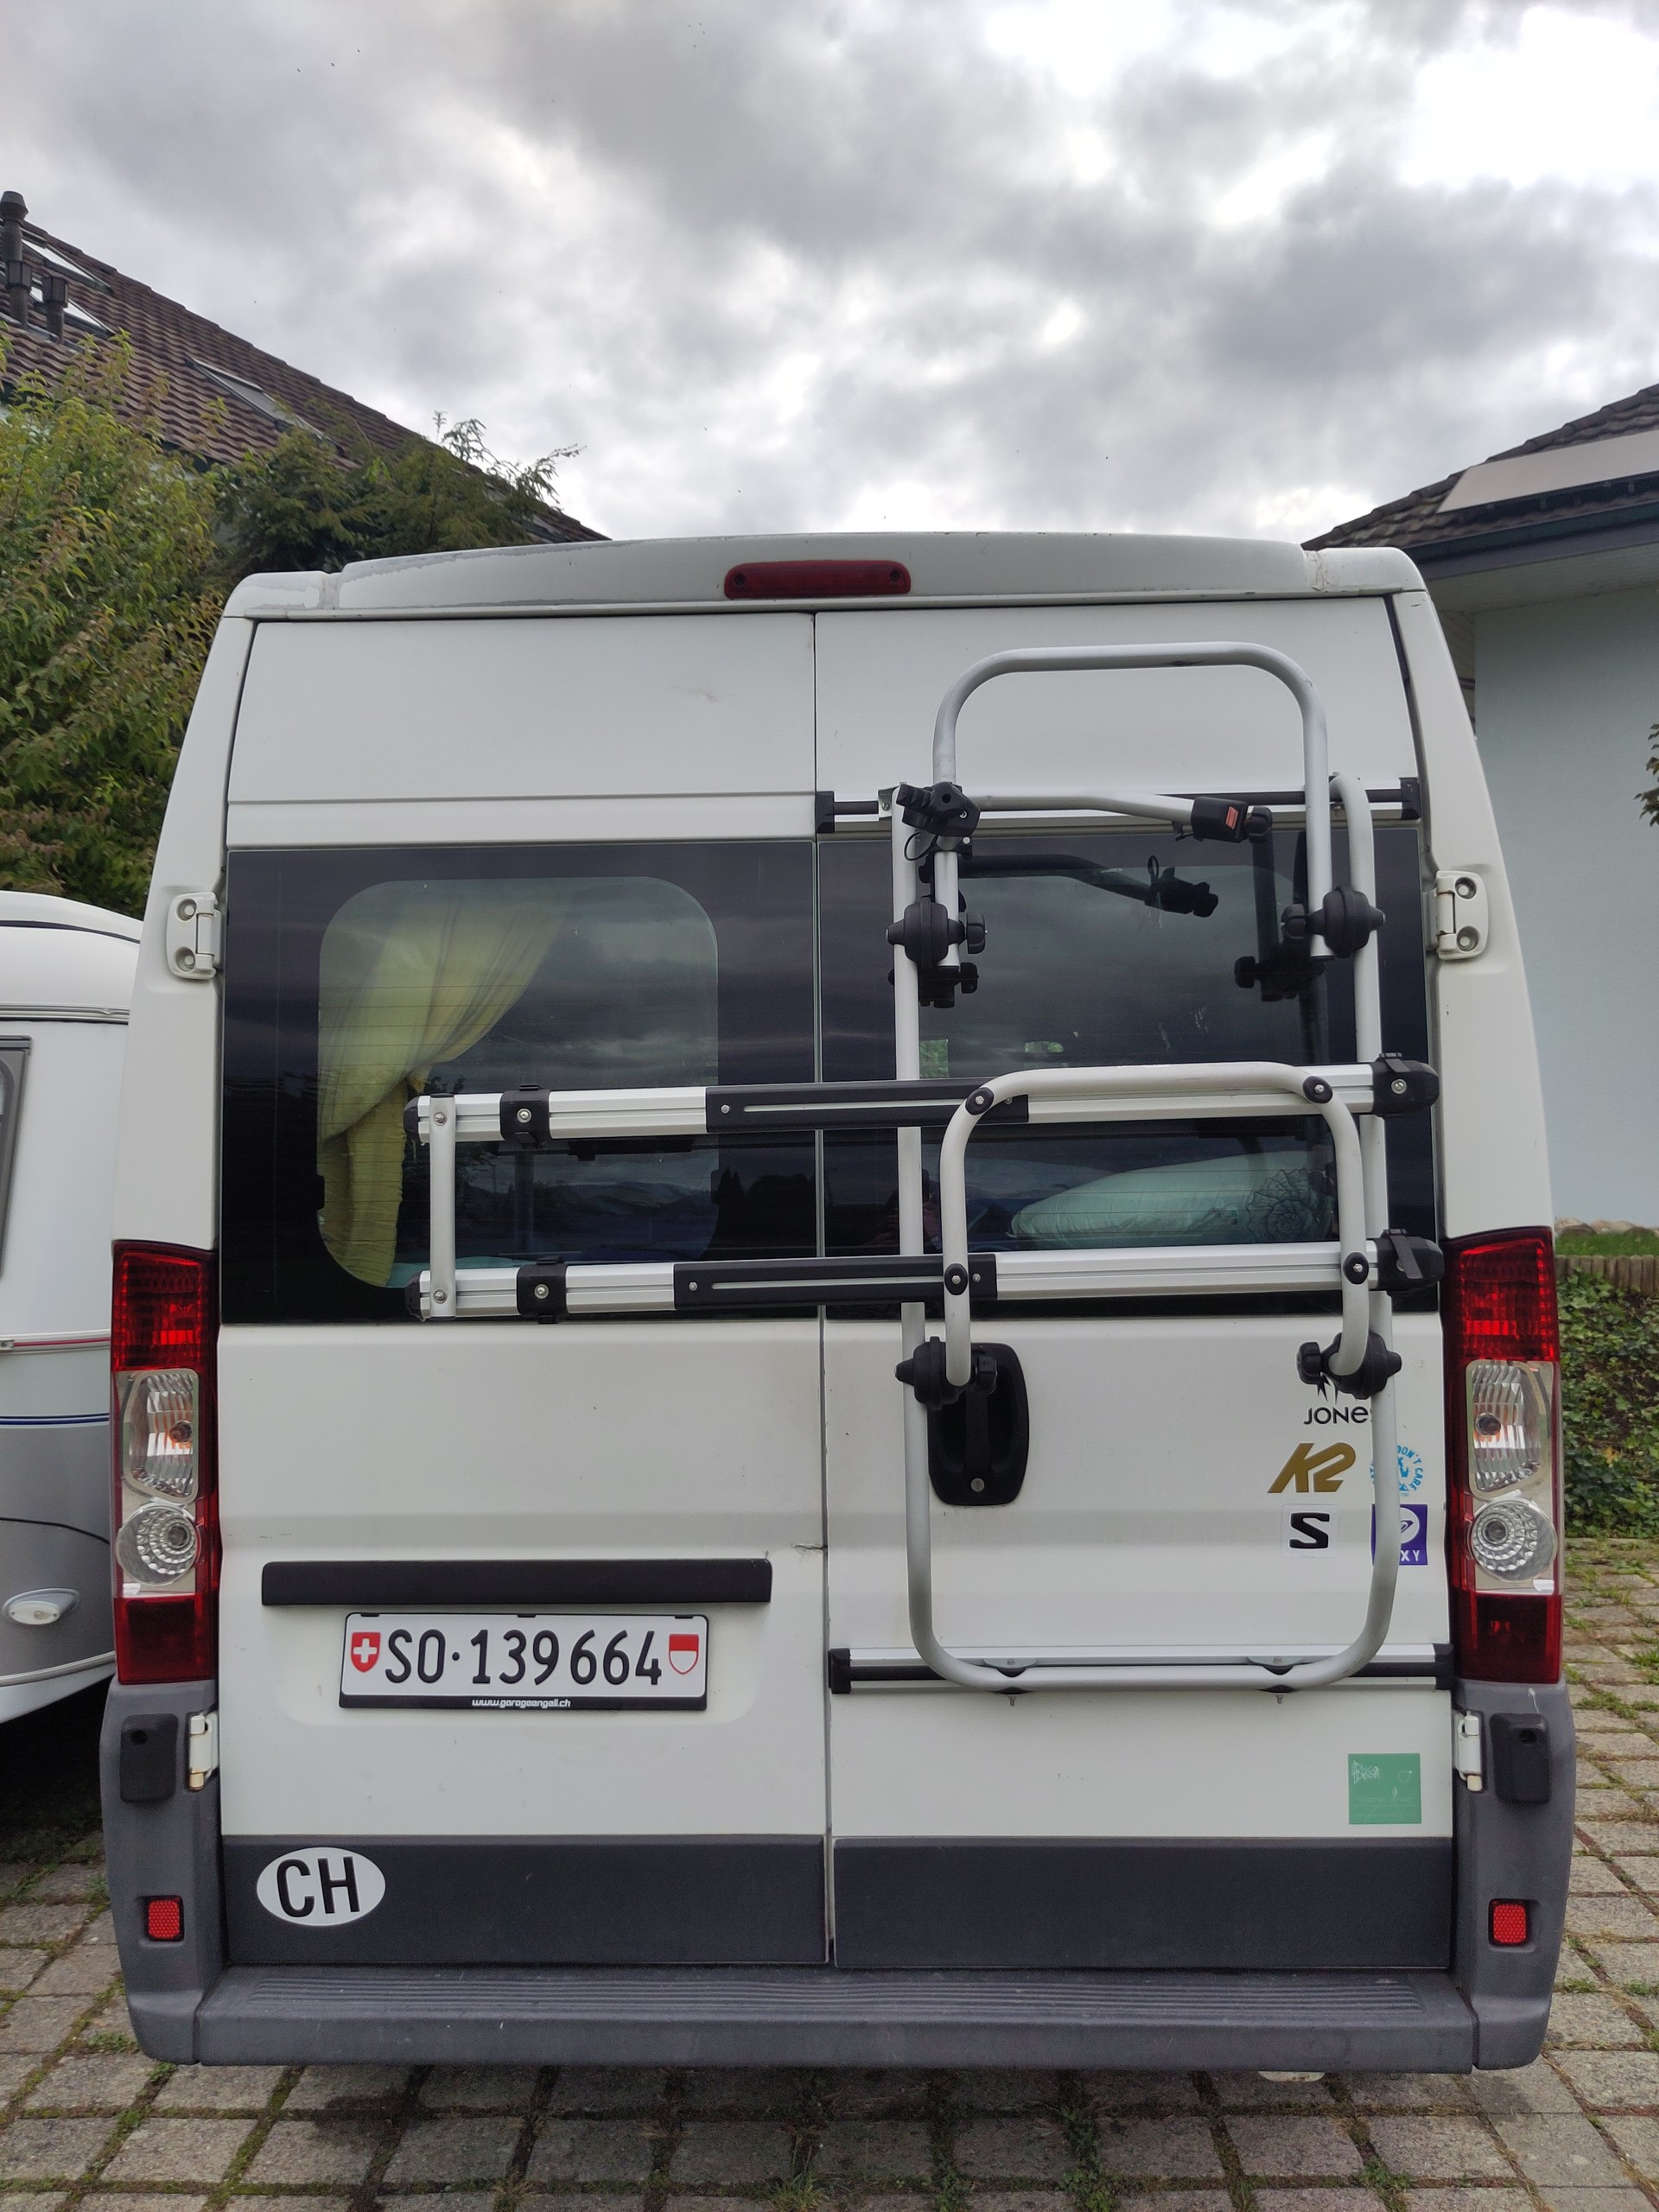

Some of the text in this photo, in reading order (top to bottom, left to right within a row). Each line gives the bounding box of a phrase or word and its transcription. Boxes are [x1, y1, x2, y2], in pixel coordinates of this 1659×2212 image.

[1303, 1406, 1372, 1425] JONe
[1267, 1442, 1357, 1494] K2
[276, 1856, 360, 1918] CH
